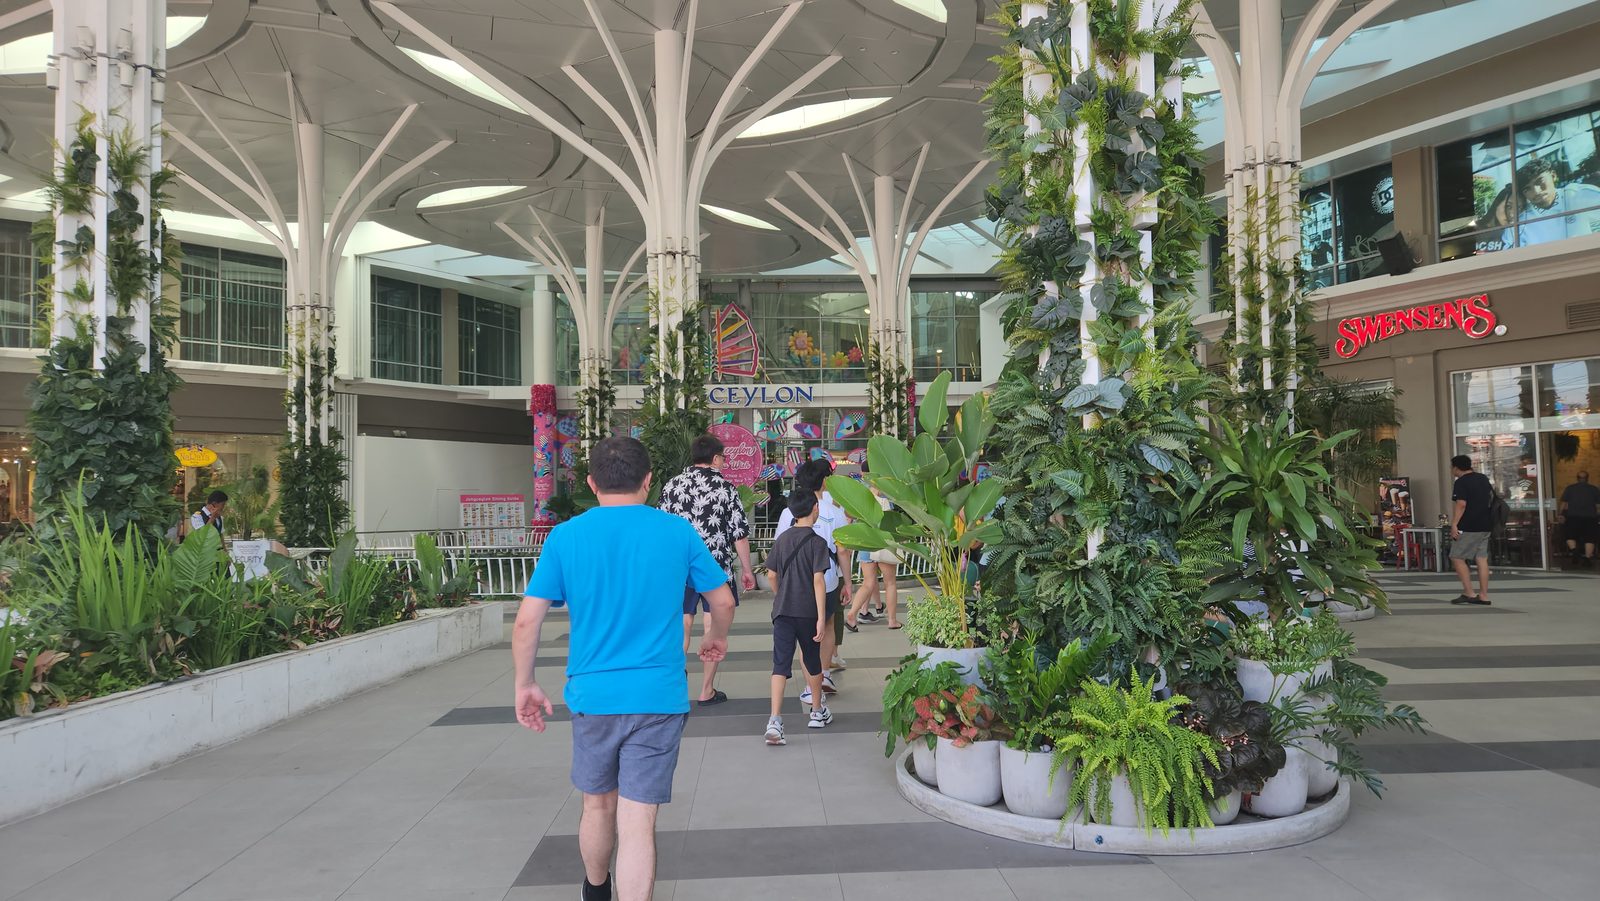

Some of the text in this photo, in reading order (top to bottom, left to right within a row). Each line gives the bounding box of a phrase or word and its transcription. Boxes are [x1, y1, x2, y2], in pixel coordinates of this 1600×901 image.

[1335, 294, 1497, 359] SWENSEN'S
[635, 386, 814, 407] CEYLON
[234, 555, 263, 564] ECURITY
